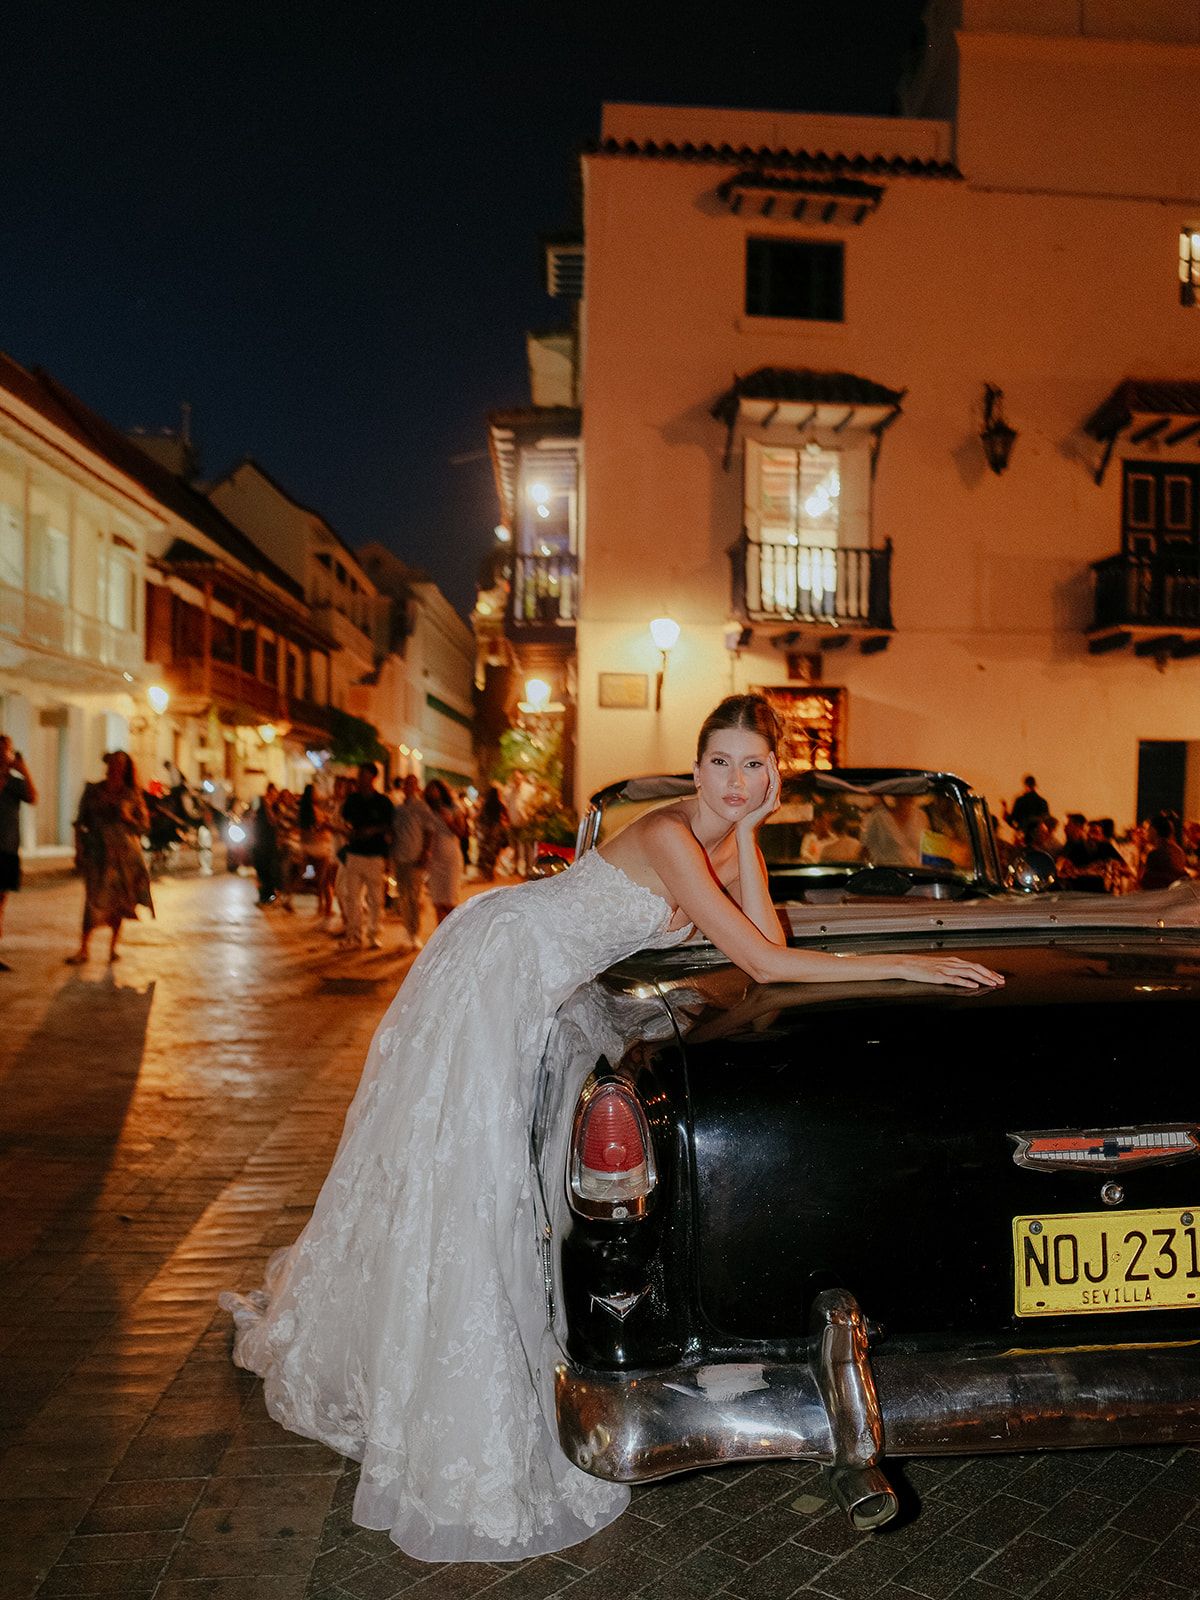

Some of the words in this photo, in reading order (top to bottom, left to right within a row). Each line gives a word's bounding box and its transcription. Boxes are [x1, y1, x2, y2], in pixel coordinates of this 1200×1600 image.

[1023, 1232, 1108, 1287] NOJ
[1123, 1227, 1200, 1281] 231
[1082, 1287, 1152, 1304] SEVILLA
